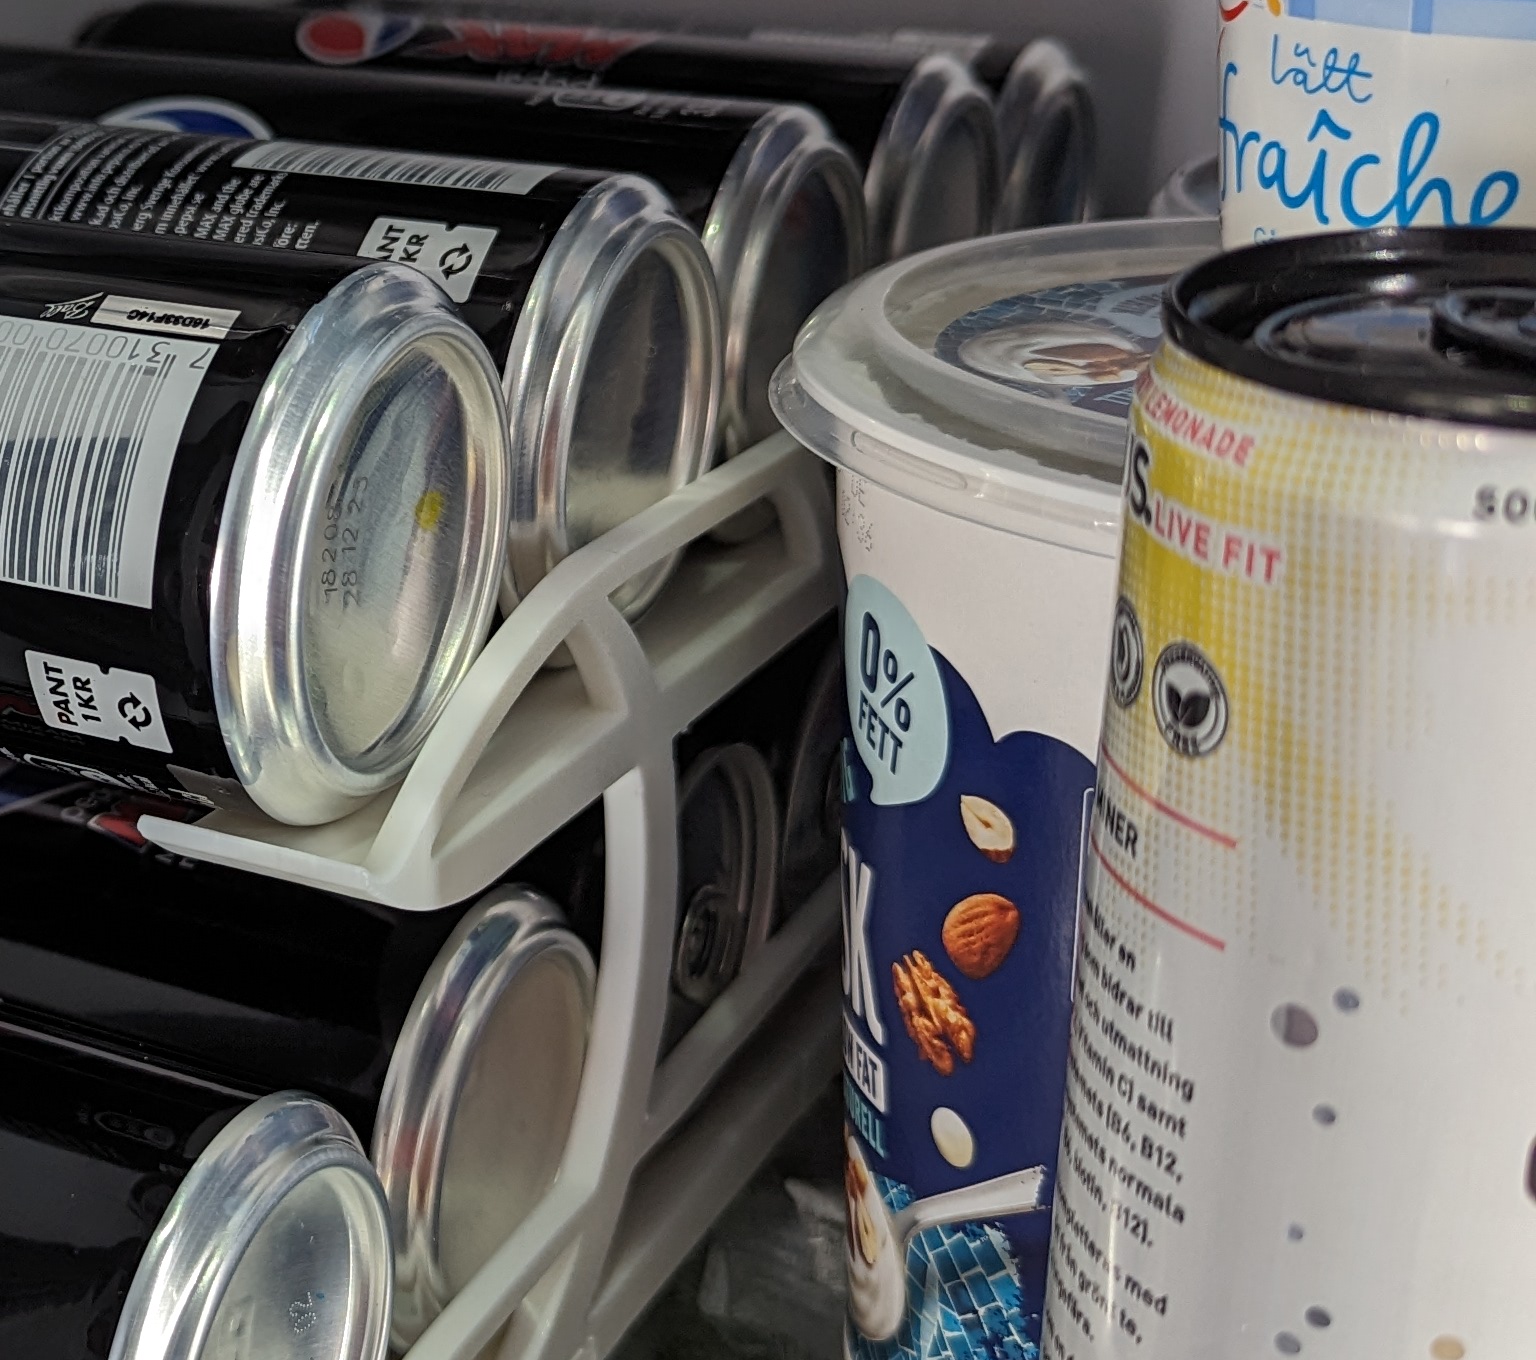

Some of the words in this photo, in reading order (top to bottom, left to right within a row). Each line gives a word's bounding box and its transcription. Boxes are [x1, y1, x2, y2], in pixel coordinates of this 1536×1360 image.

[398, 235, 429, 263] KR
[46, 327, 171, 364] 310070
[189, 347, 211, 370] 7
[1145, 387, 1256, 468] LEMONADE
[1153, 499, 1212, 561] LIVE
[1221, 534, 1282, 585] FIT
[43, 661, 79, 727] PANT
[72, 676, 102, 723] 1KR
[860, 611, 915, 733] 0%
[858, 690, 903, 776] FETT
[1101, 1013, 1195, 1104] utmattning
[1124, 1273, 1167, 1317] med
